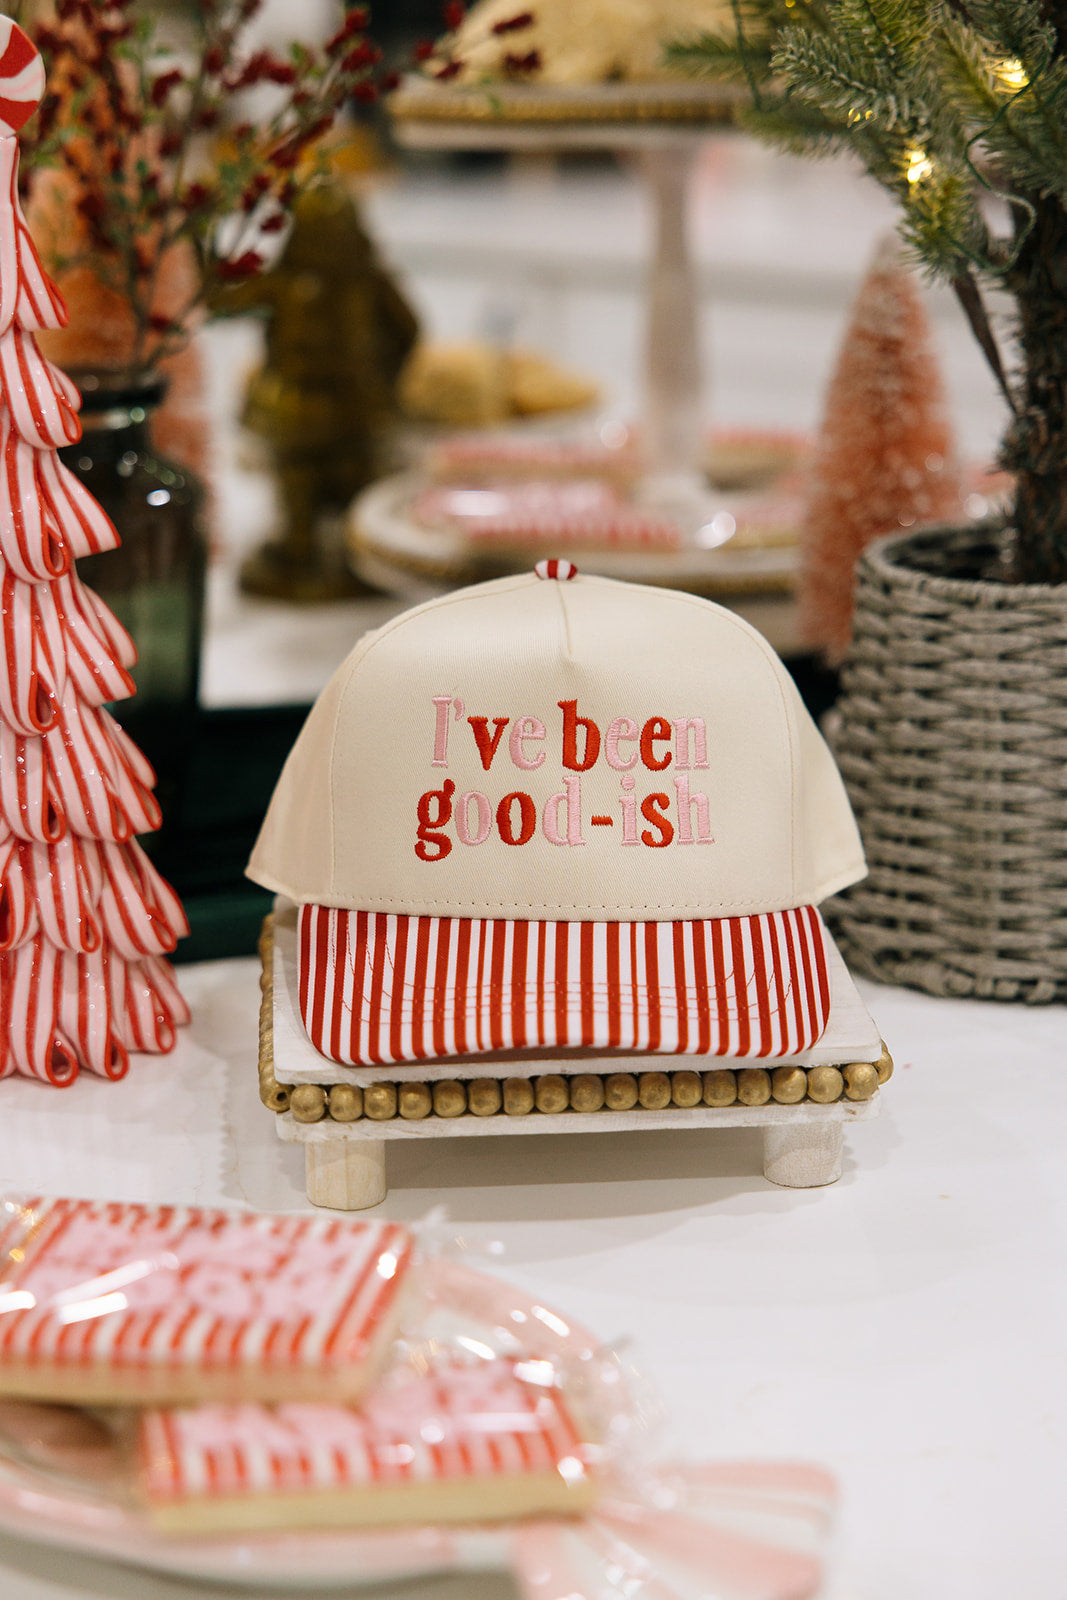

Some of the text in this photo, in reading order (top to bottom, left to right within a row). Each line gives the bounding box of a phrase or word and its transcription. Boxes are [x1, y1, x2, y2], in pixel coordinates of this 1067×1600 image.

[431, 695, 710, 772] I've been
[414, 775, 716, 862] good-ish
